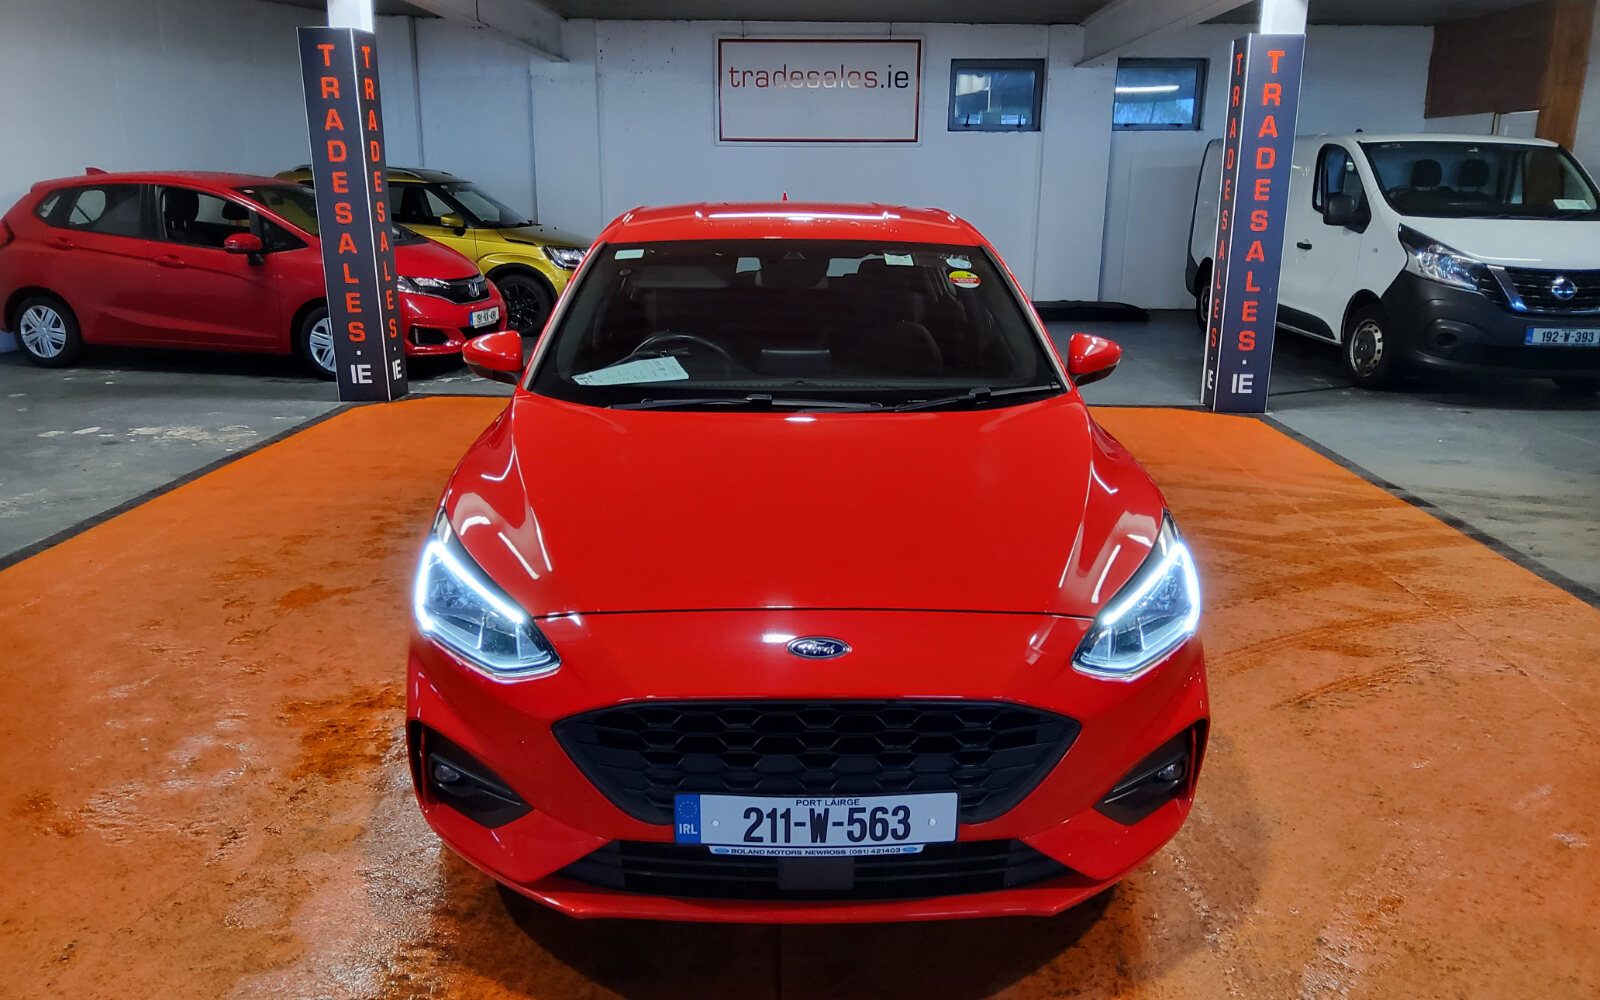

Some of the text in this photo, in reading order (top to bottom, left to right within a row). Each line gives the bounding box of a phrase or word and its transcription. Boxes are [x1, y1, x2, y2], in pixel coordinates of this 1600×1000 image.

[729, 64, 909, 89] tradesales.ie
[1542, 331, 1594, 342] 192-W-393
[824, 798, 861, 806] LÁIRGE
[679, 824, 698, 834] IRL
[743, 805, 911, 843] 211-W-563
